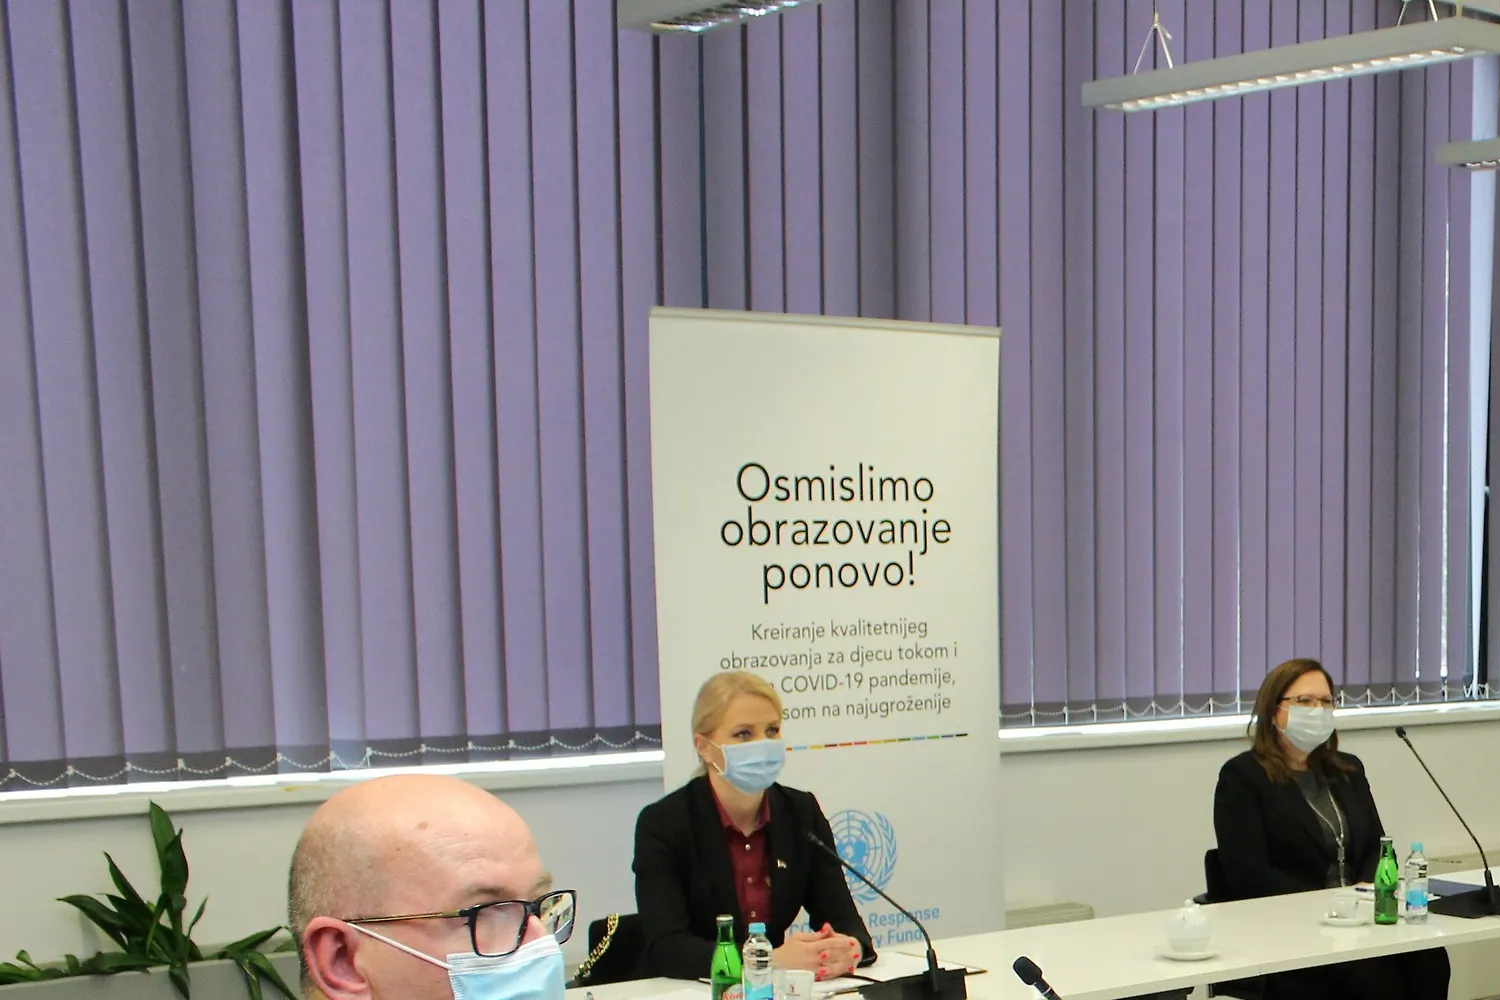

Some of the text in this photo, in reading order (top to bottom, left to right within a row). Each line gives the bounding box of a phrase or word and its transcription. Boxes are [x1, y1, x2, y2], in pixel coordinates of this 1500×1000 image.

[736, 461, 935, 502] Osmislimo
[720, 505, 952, 556] obrazovanje
[762, 550, 916, 605] ponovo!
[751, 617, 928, 643] Kreiranje kvalitetnijeg
[720, 643, 958, 670] obrazovanja za djecu tokom i
[780, 668, 956, 694] COVID-19 pandemije,
[782, 693, 951, 720] som na najugroženije
